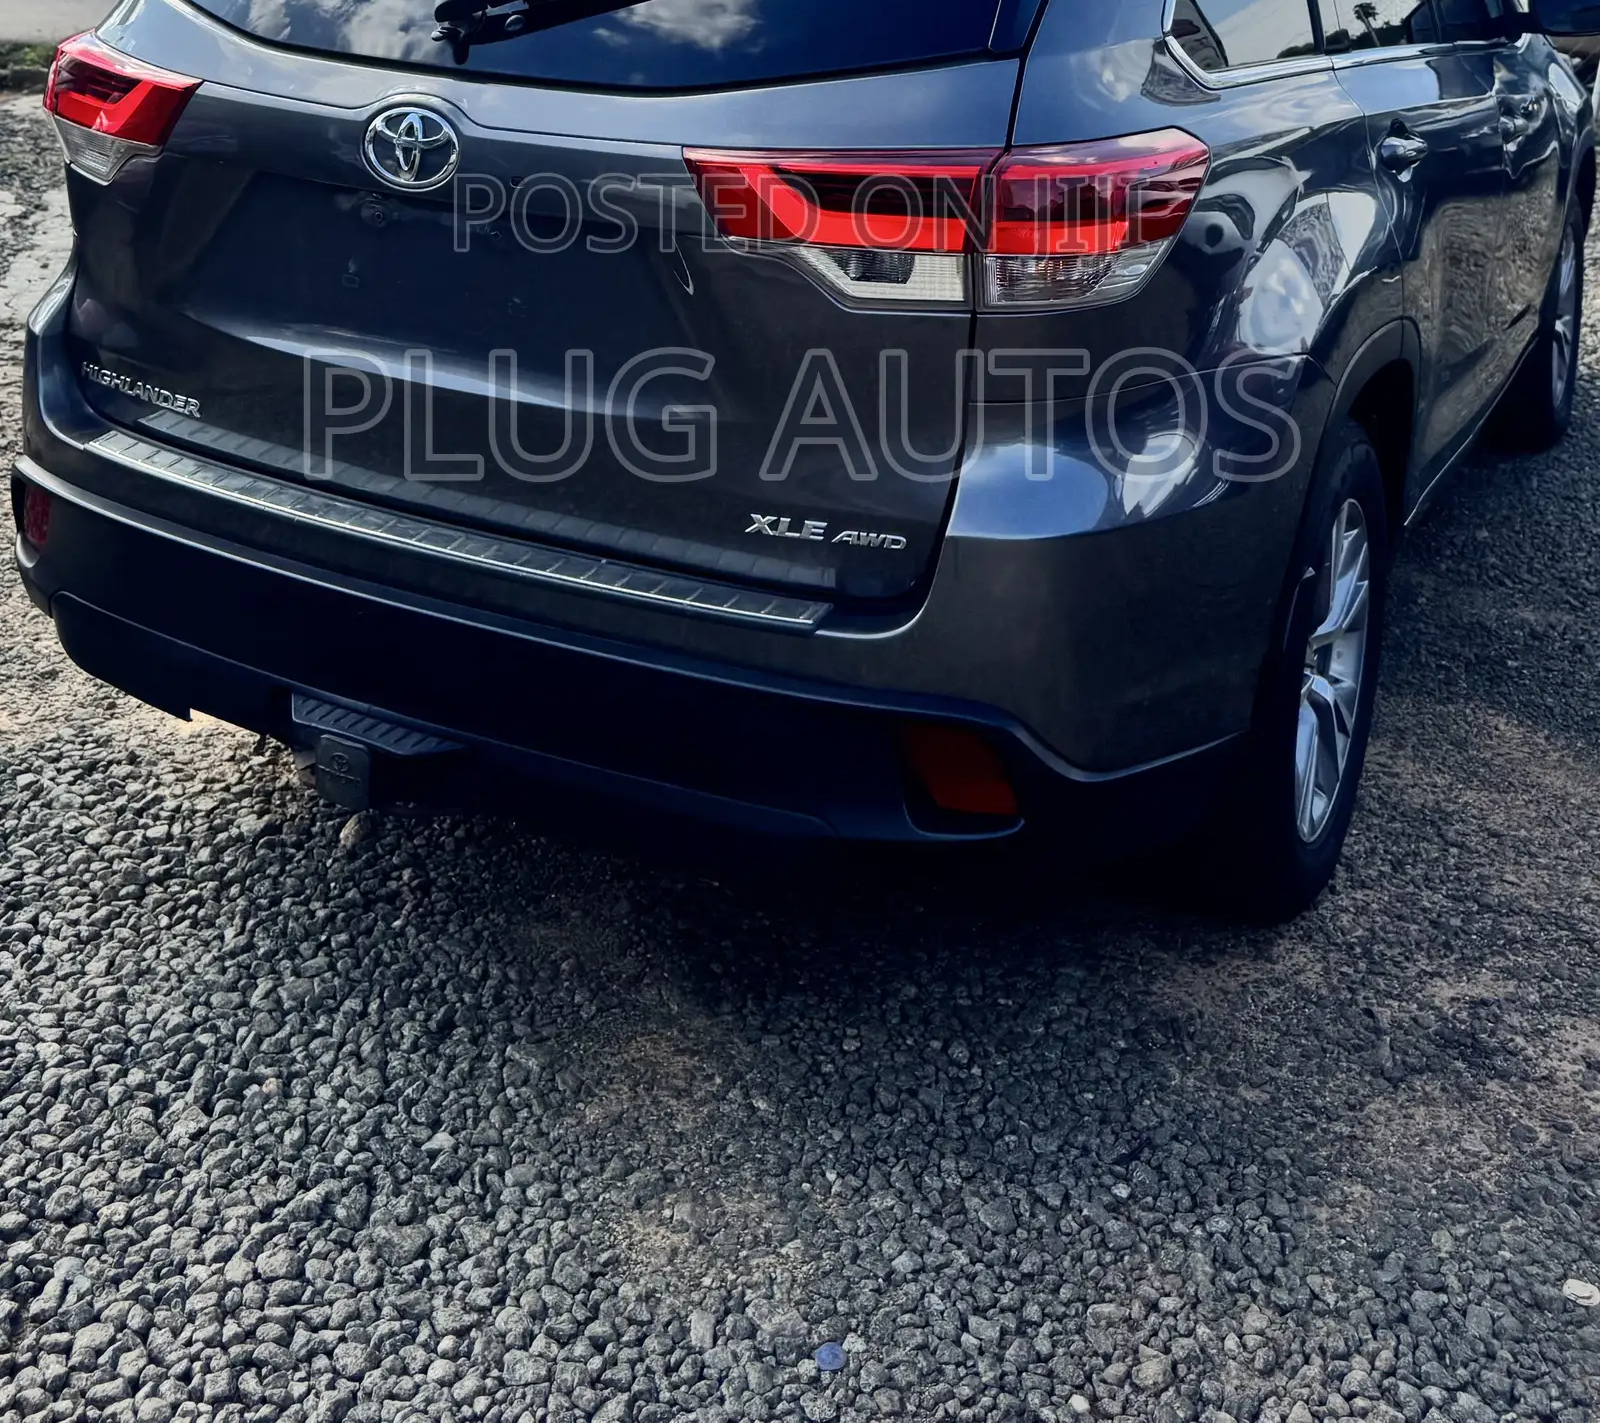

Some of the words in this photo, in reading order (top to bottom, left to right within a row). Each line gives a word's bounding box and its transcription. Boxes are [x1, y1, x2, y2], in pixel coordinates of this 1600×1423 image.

[81, 361, 201, 418] HIGHLANDER
[744, 513, 828, 541] XLE
[831, 530, 907, 550] AWD
